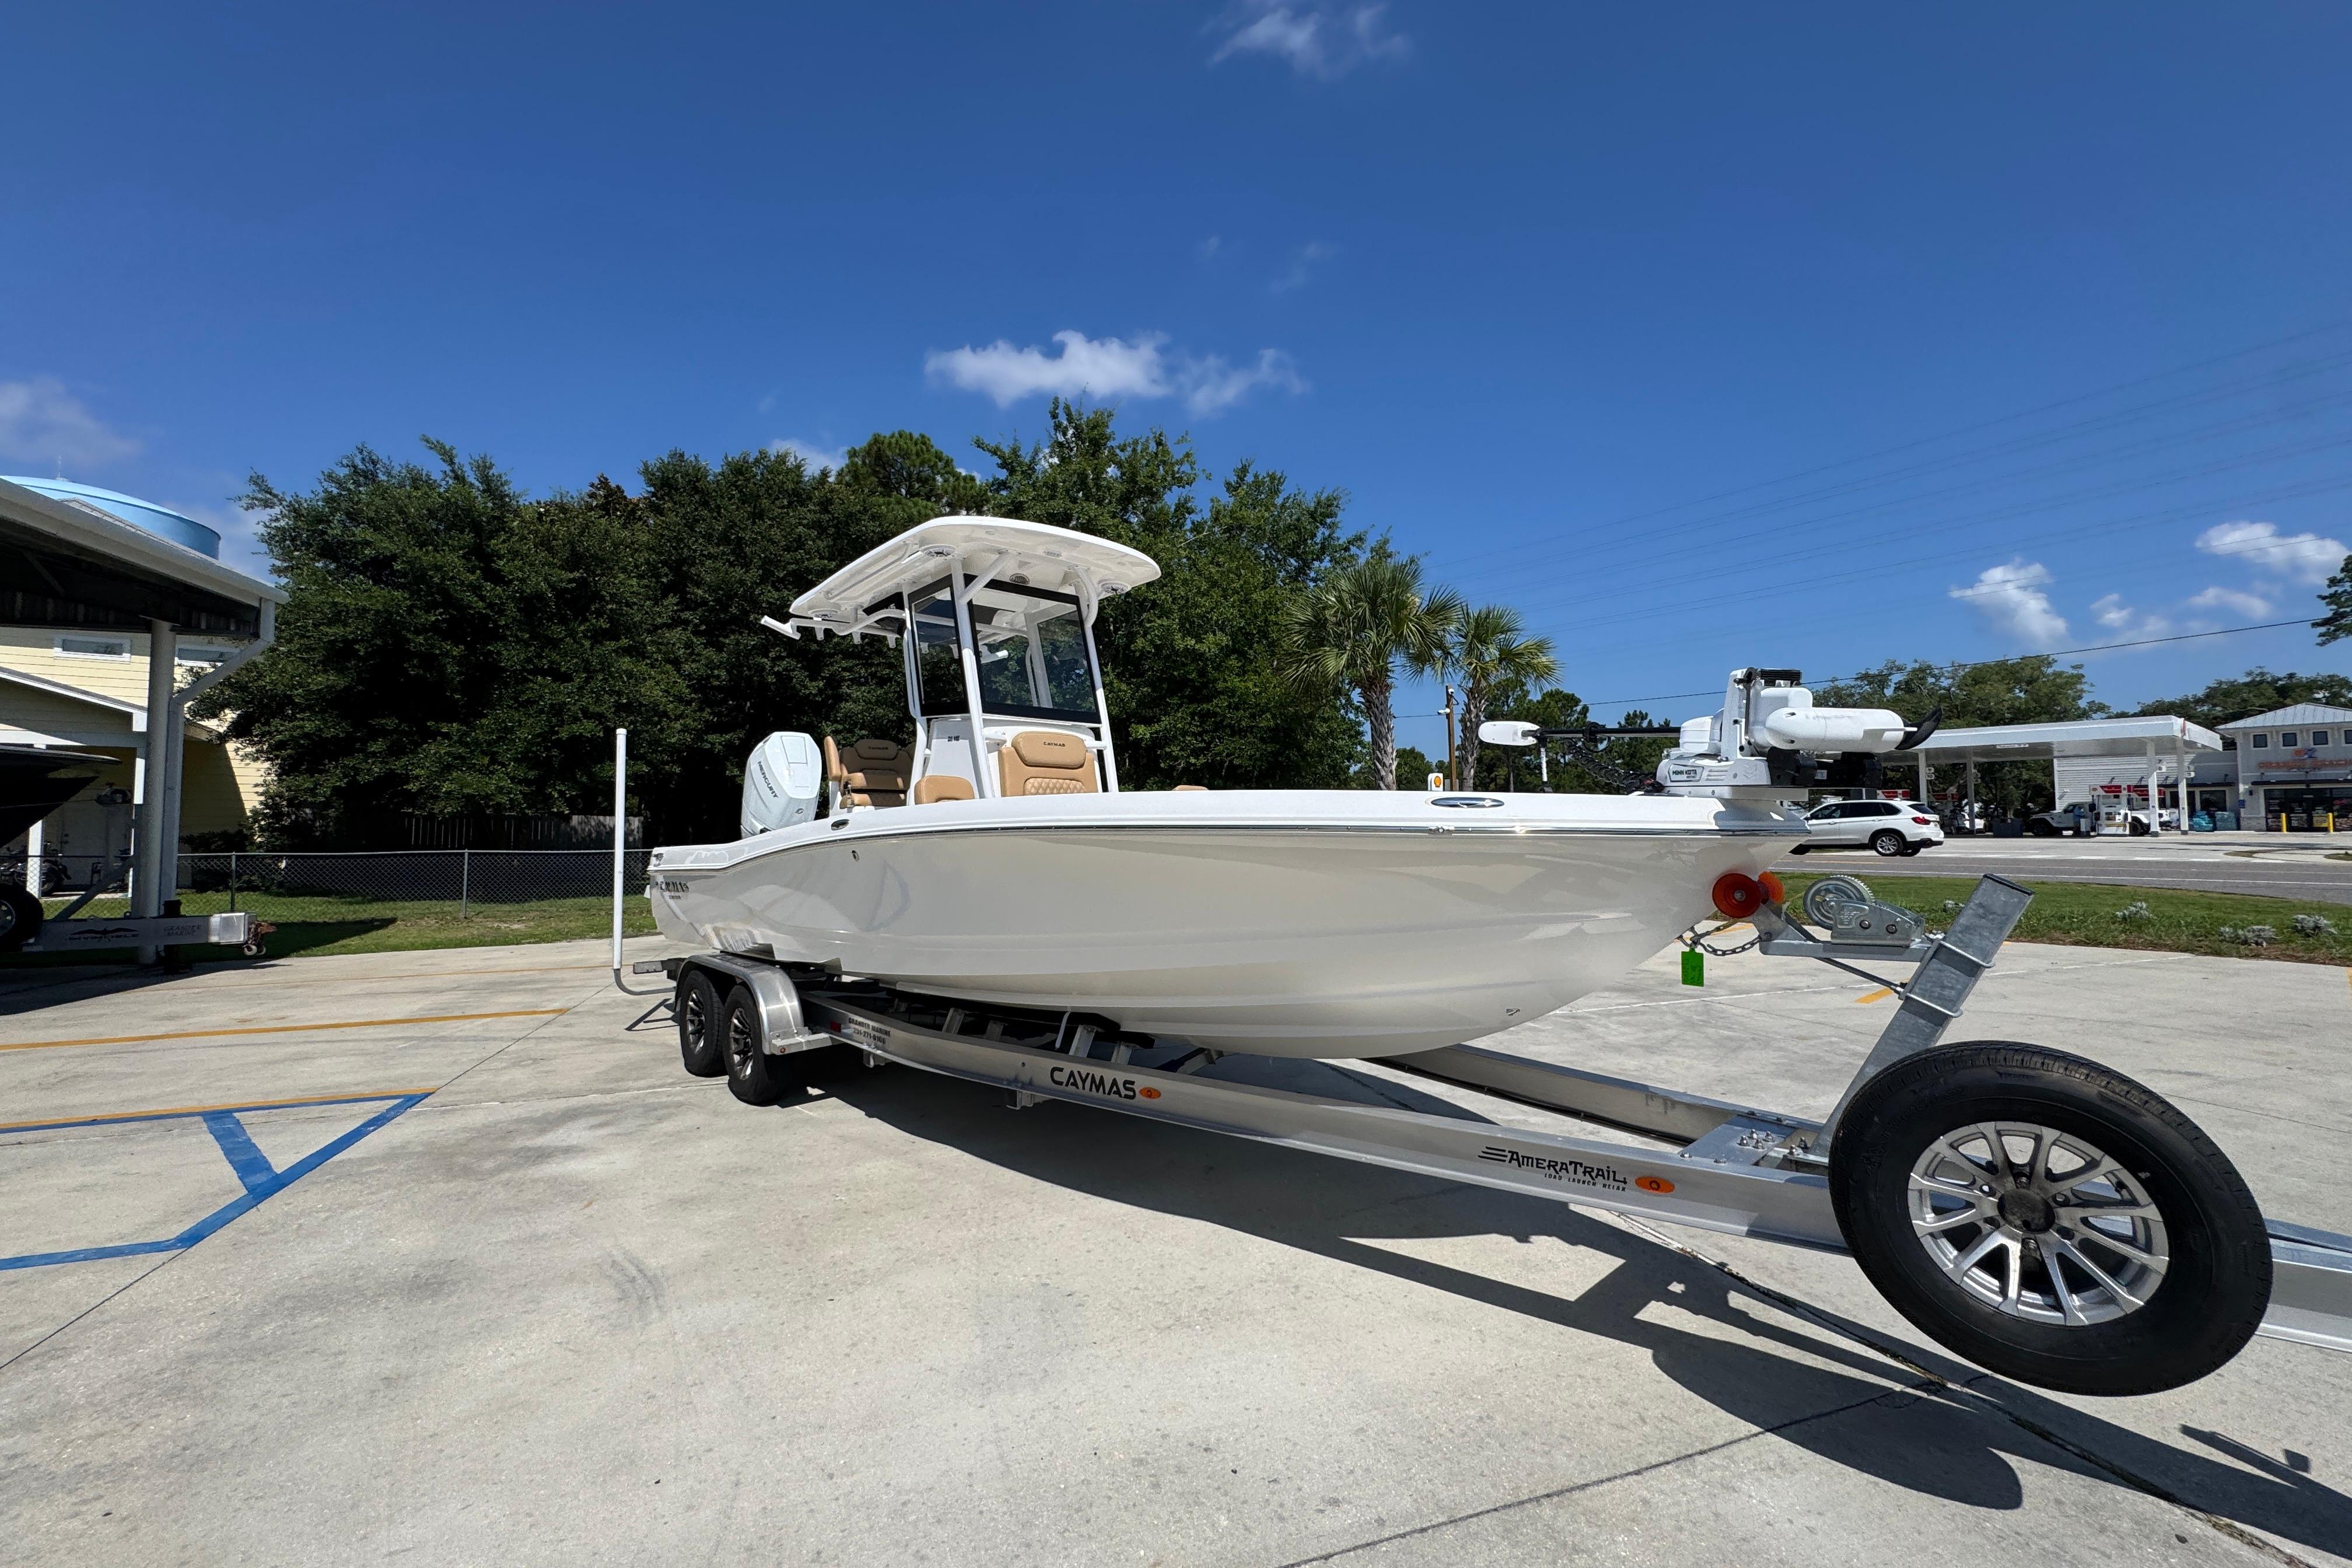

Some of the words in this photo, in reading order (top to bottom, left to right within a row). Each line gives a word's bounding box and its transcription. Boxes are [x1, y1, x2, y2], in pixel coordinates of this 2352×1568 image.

[757, 760, 779, 798] MERCURY
[848, 1017, 870, 1030] GRANDER
[871, 1025, 891, 1037] MARINE
[1050, 1066, 1136, 1100] CAYMAS
[1544, 1172, 1563, 1181] LOAD
[1567, 1177, 1597, 1187] LAUNCH
[1602, 1183, 1626, 1192] RELAX
